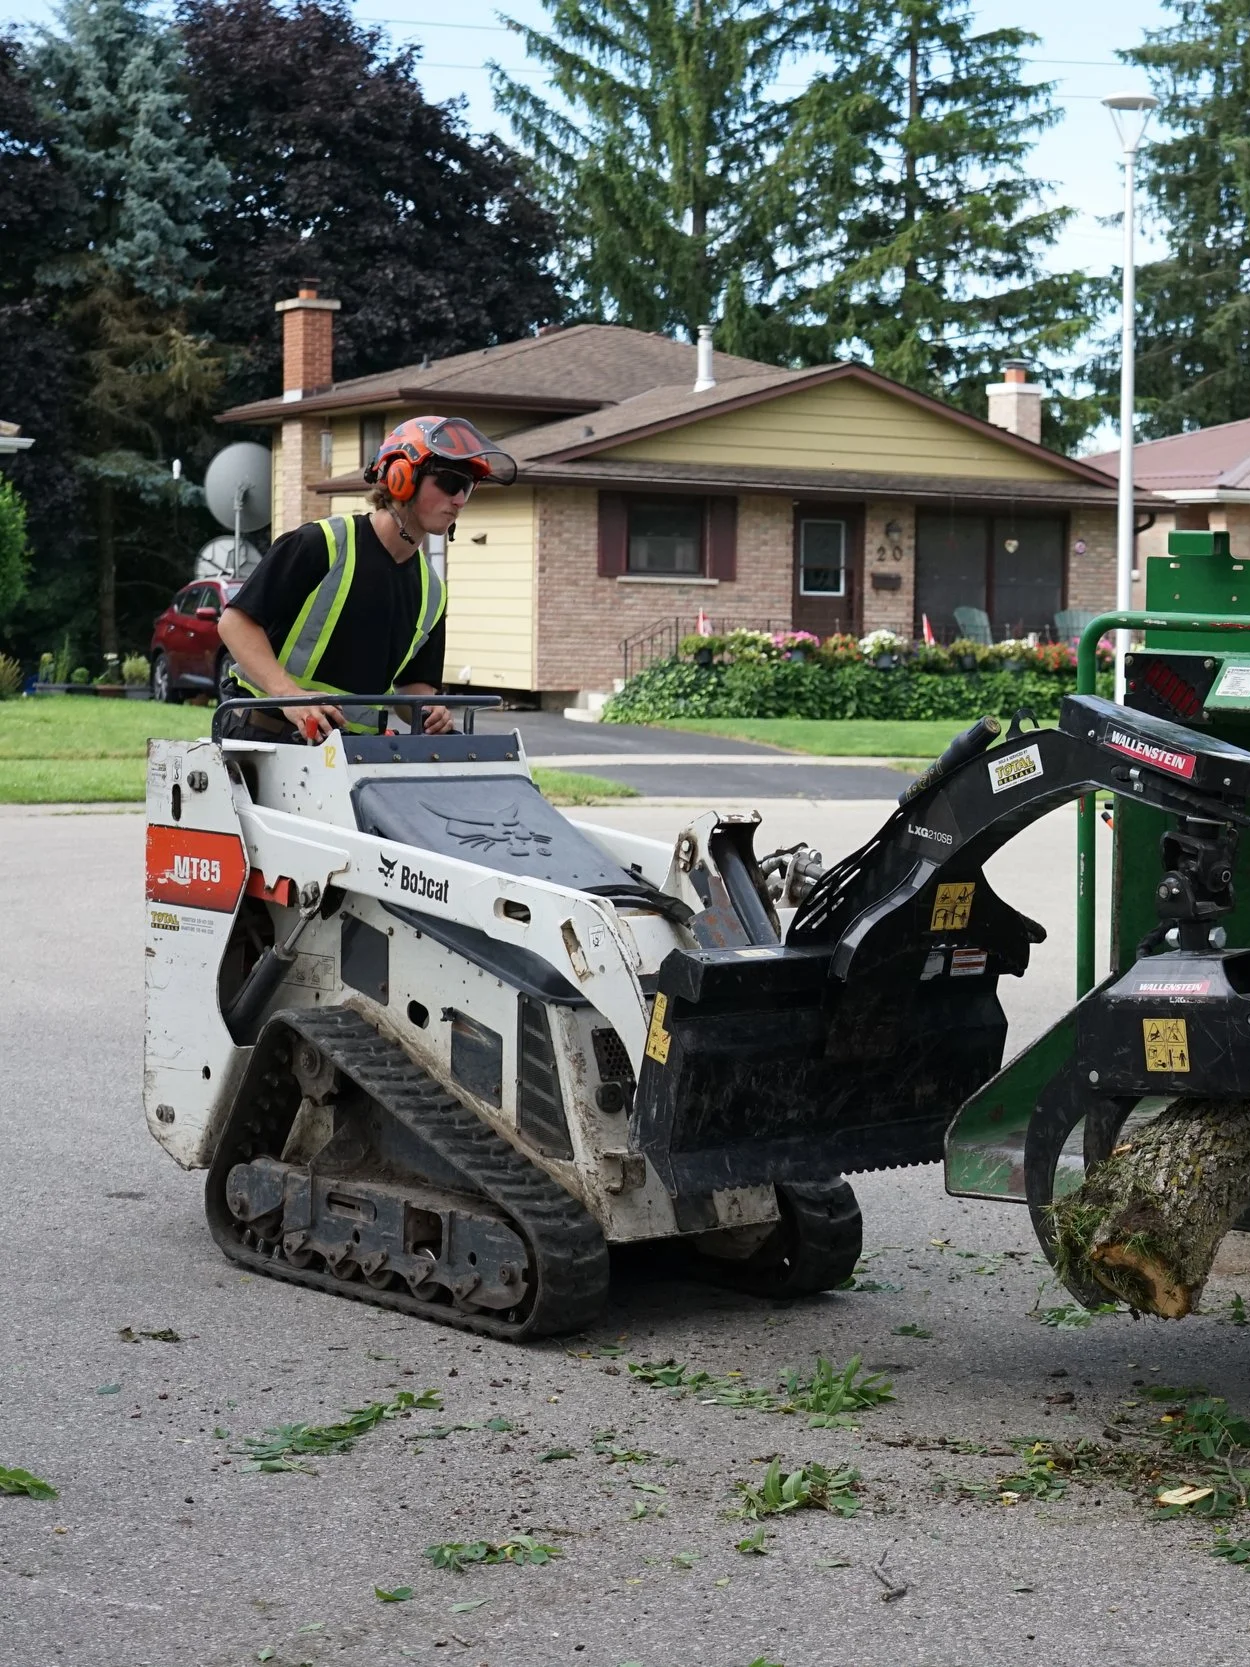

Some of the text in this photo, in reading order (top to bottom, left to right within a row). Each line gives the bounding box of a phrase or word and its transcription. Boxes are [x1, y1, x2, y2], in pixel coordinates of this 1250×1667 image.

[876, 545, 904, 562] 20
[324, 746, 337, 768] 12
[1111, 730, 1186, 770] WALLENSTEIN
[995, 754, 1035, 779] TOTAL
[997, 765, 1036, 787] RENTALS
[907, 823, 953, 845] LXG210SB
[174, 854, 221, 883] MT85
[400, 865, 450, 904] Bobcat
[150, 911, 180, 925] TOTAL
[1139, 983, 1203, 991] WALLENSTEIN
